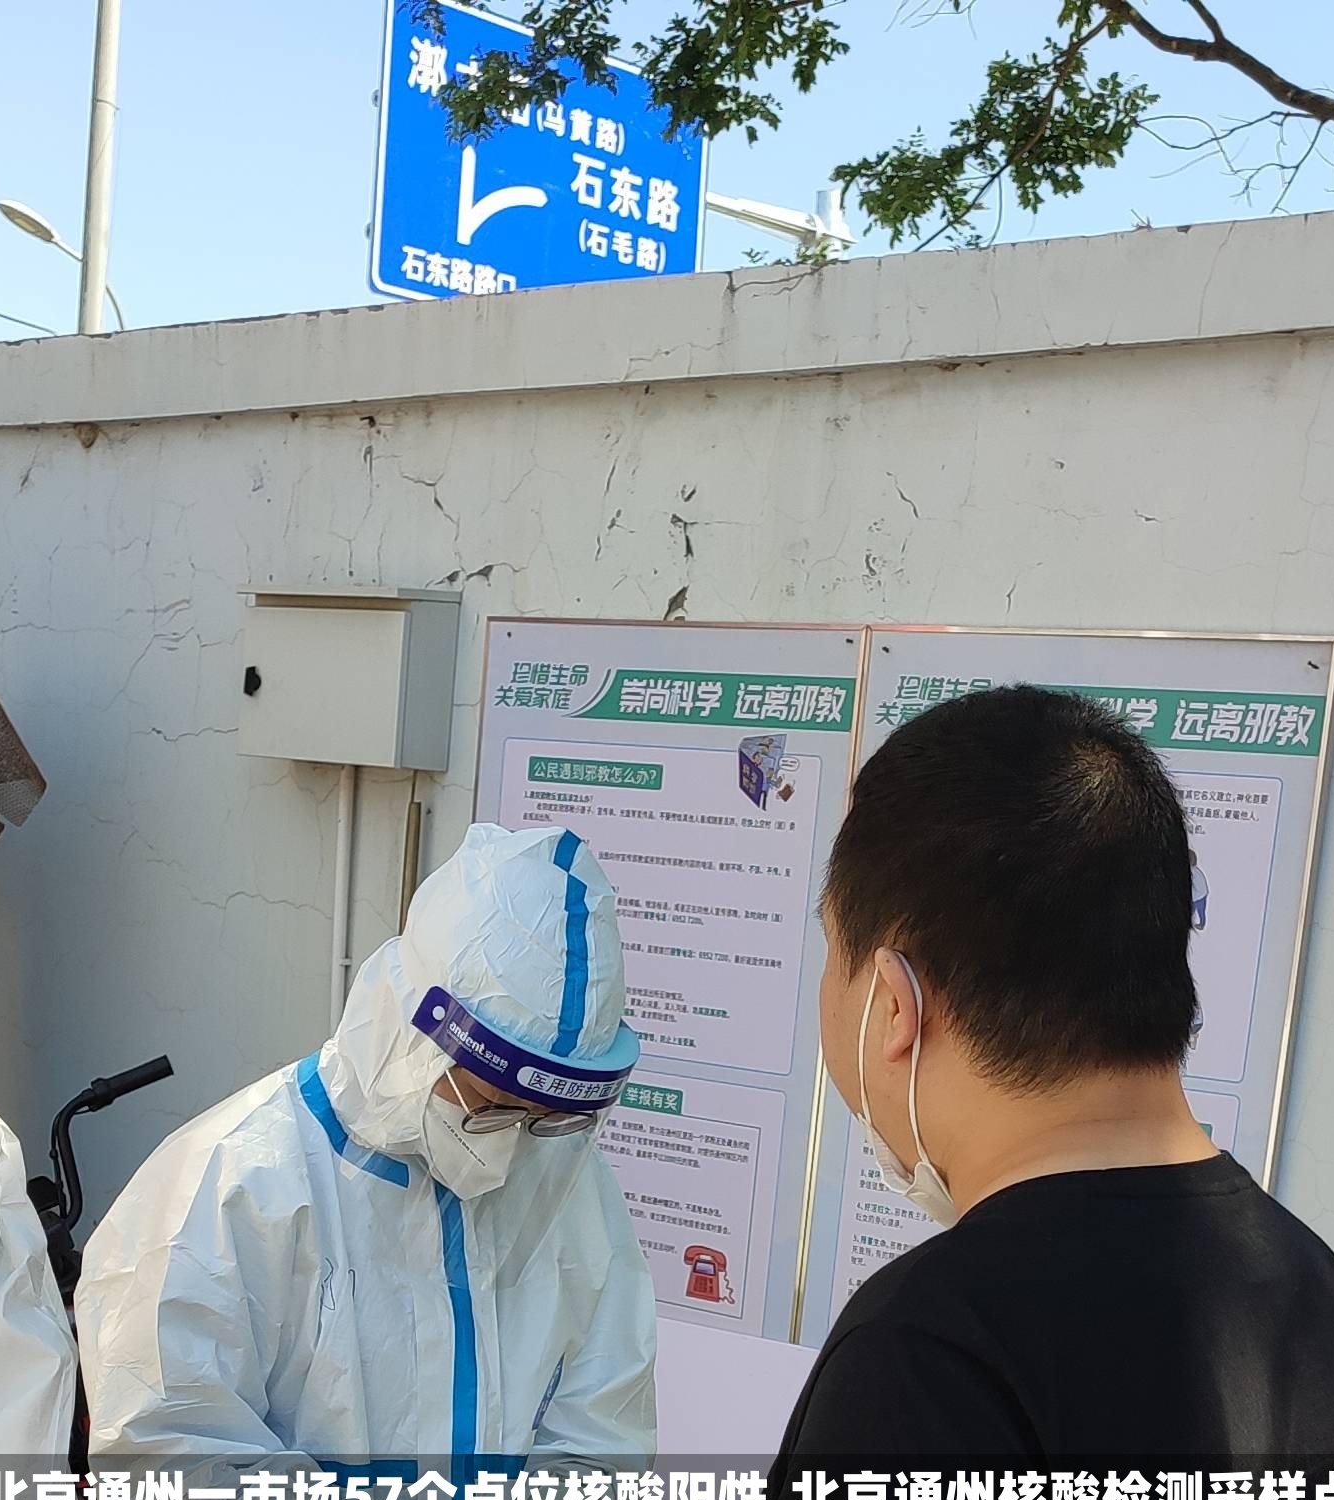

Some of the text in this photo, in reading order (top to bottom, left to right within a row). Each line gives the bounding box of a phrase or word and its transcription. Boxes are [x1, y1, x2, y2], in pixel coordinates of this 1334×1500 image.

[570, 151, 681, 232] 石东路
[578, 218, 667, 273] (石毛路)
[511, 662, 589, 686] 珍惜生命
[494, 686, 573, 710] 关爱家庭
[619, 678, 847, 723] 崇尚科学 远离邪教
[1171, 700, 1316, 746] 远离邪教
[533, 760, 658, 787] 公民遇到邪教怎么办?
[449, 1021, 485, 1056] andent
[625, 1086, 678, 1111] 举报有奖
